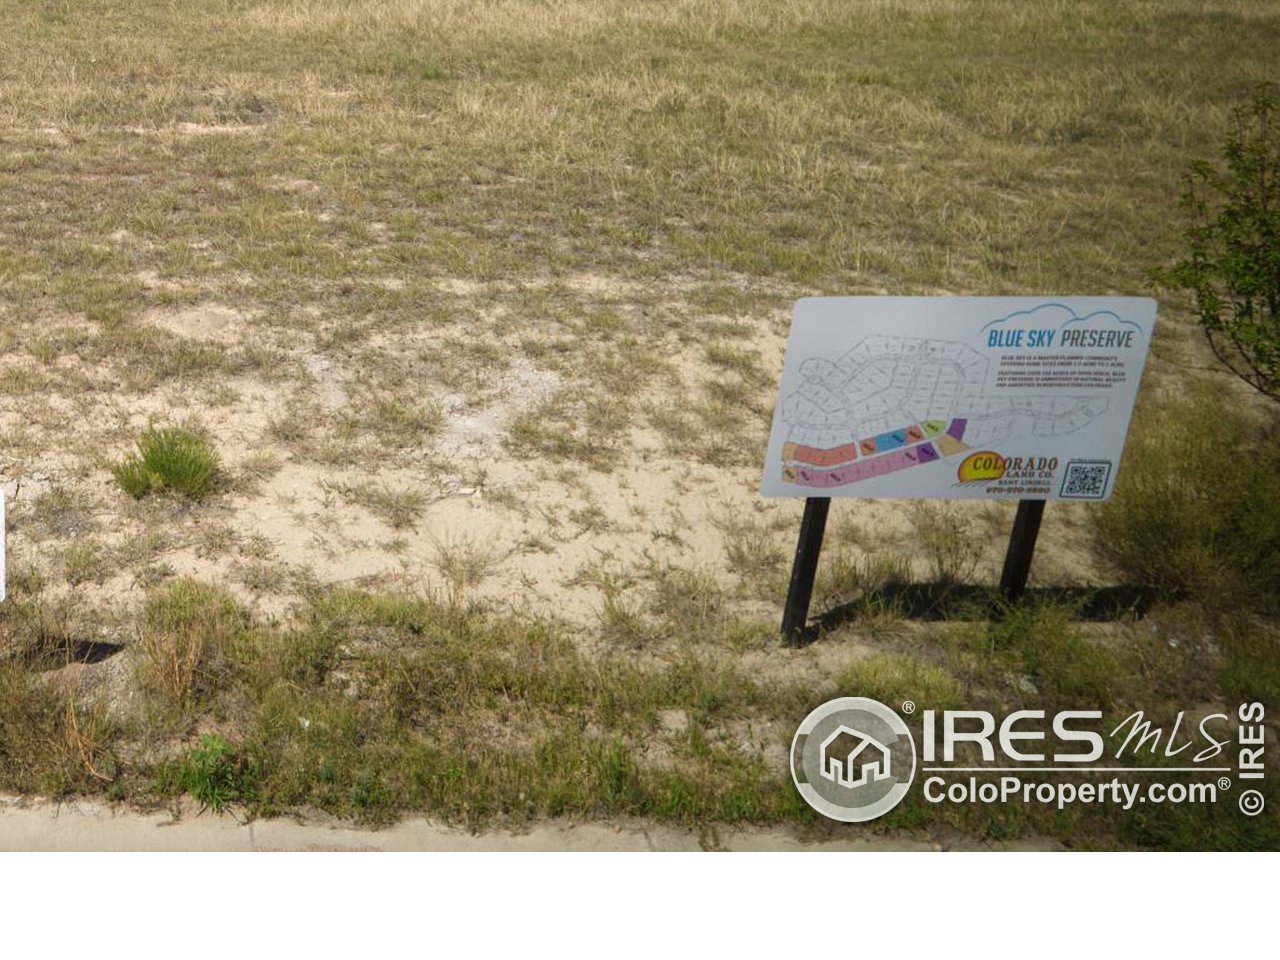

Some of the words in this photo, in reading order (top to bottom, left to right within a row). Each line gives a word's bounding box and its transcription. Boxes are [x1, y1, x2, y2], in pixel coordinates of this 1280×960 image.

[987, 330, 1024, 348] BLUE
[1026, 330, 1056, 348] SKY
[1060, 330, 1135, 349] PRESERVE
[973, 456, 1058, 471] COLORADO
